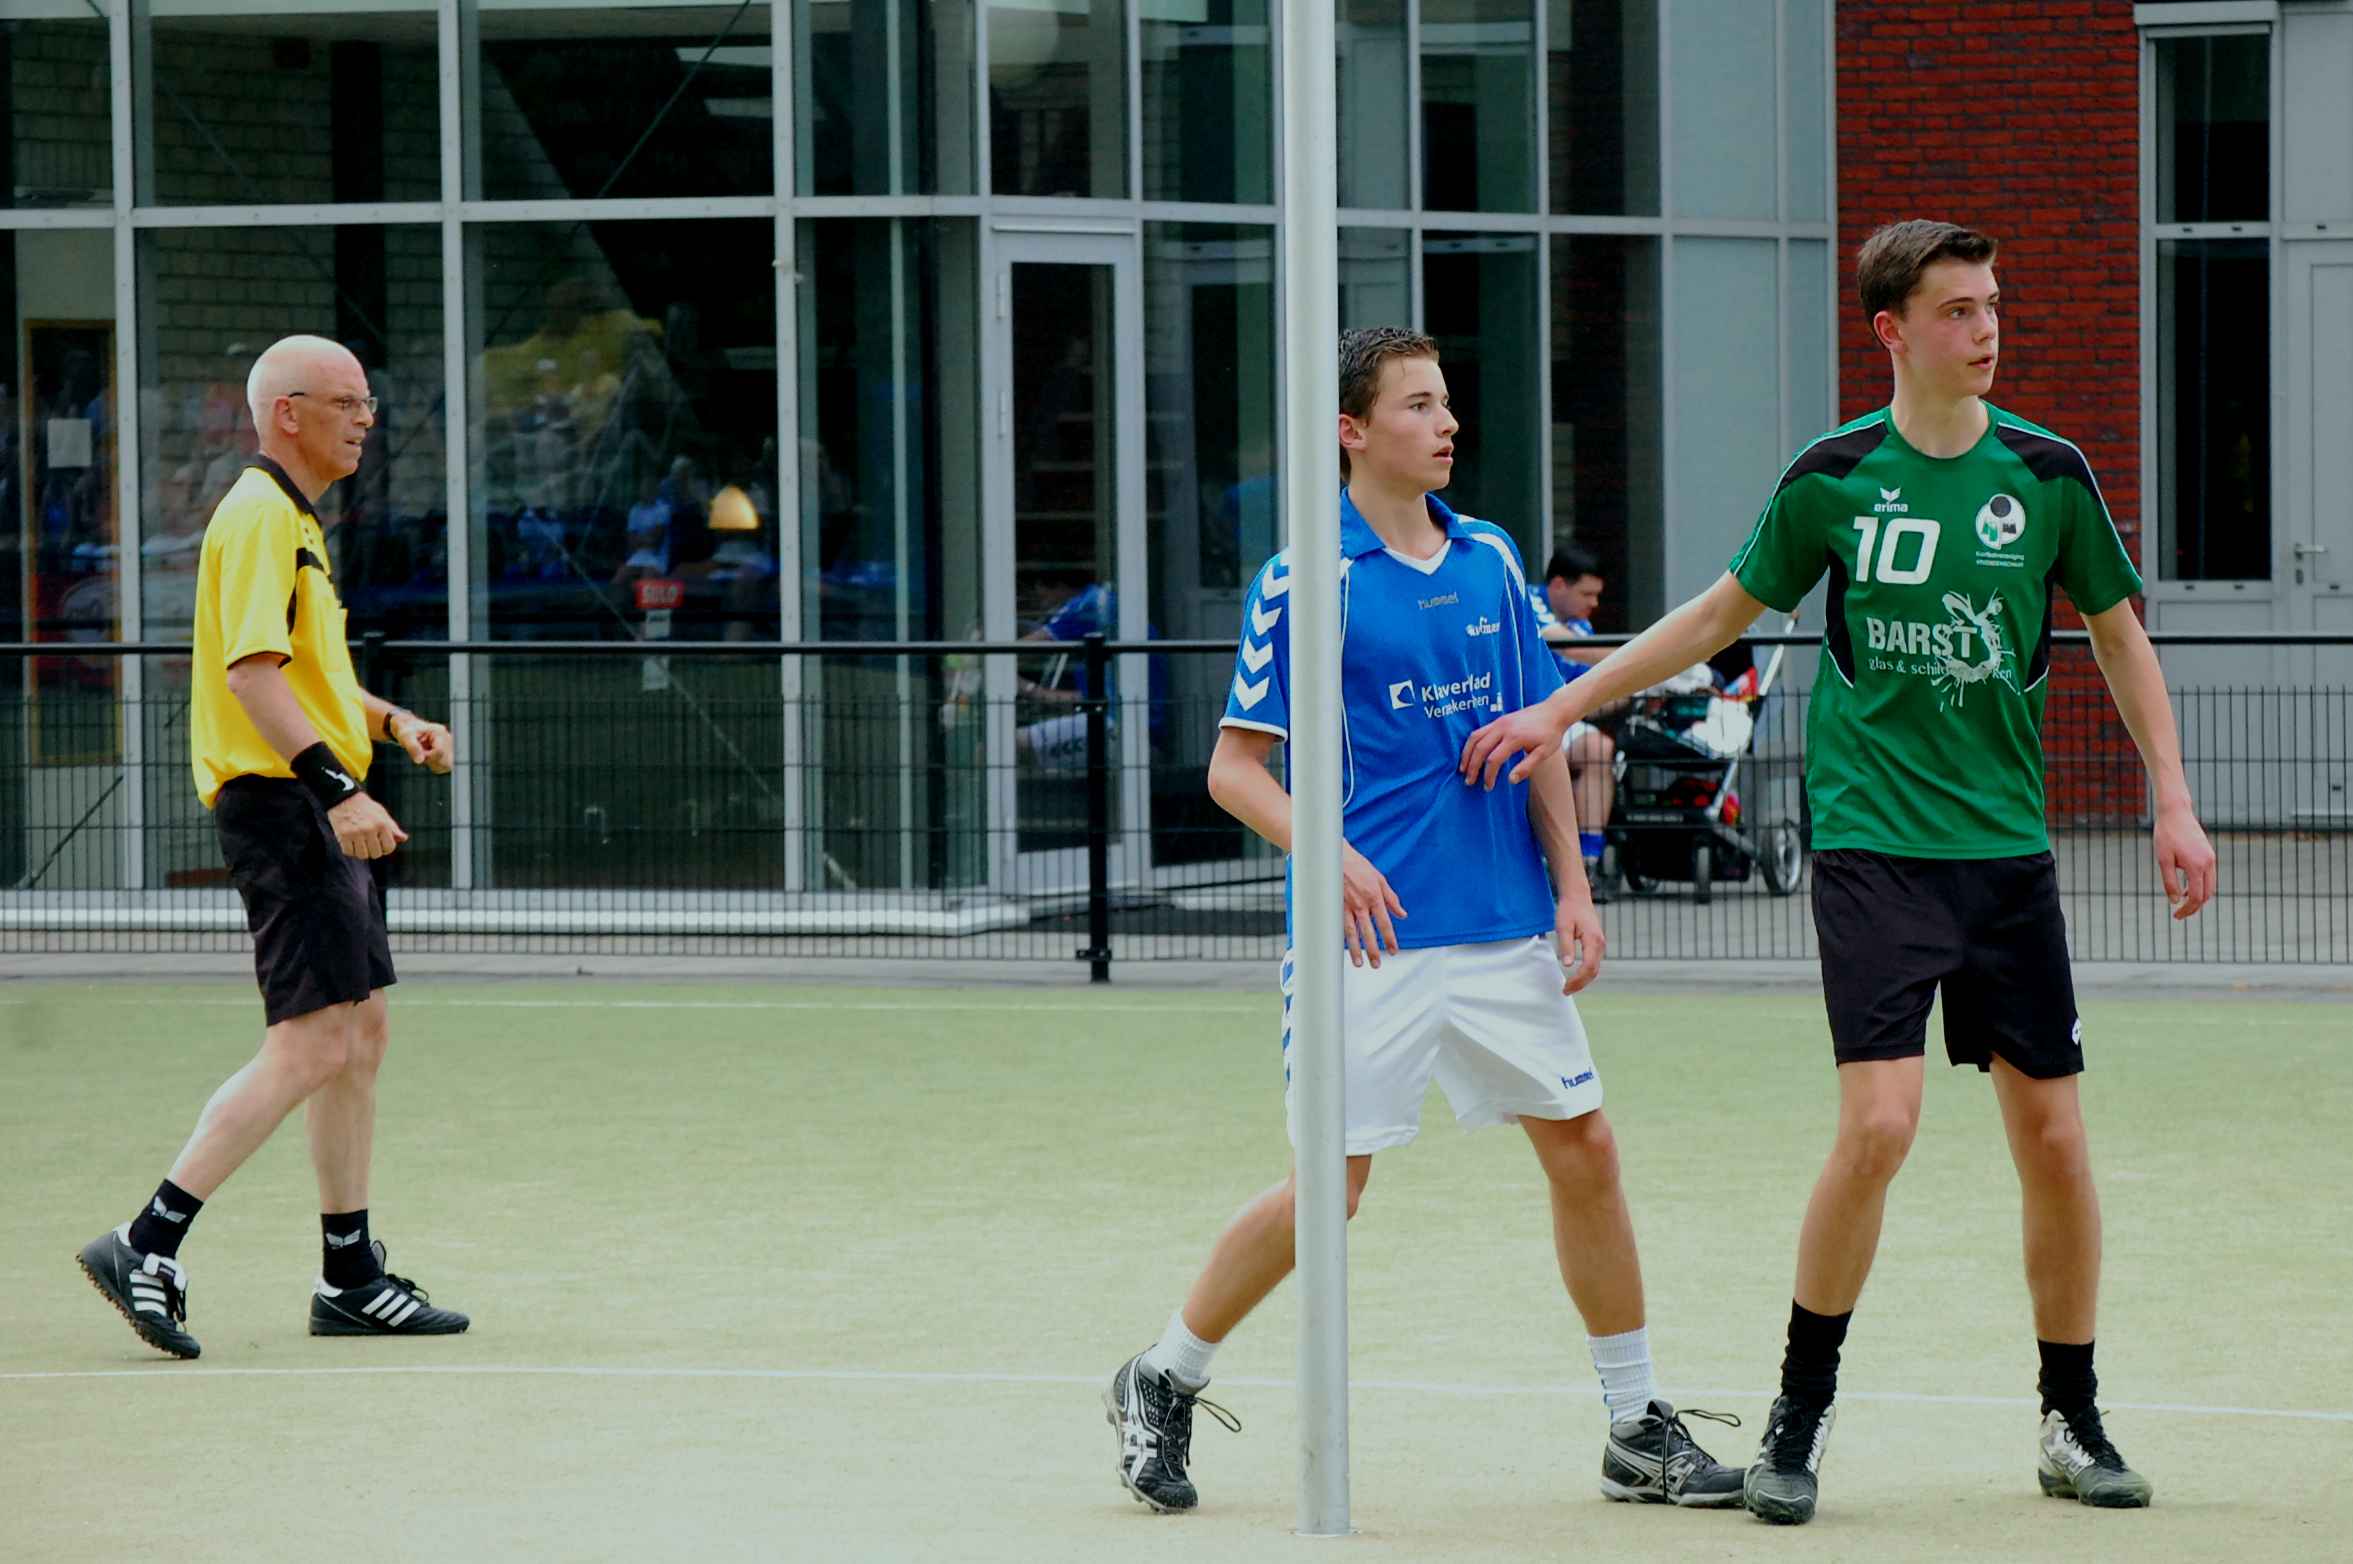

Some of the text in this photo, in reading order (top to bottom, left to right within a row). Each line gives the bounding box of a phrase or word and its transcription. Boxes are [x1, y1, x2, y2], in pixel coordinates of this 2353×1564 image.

[1874, 502, 1908, 513] erima
[1853, 515, 1941, 585] 10
[1866, 616, 1978, 659] BARST
[1869, 656, 1894, 671] glas
[1896, 660, 1906, 673] &
